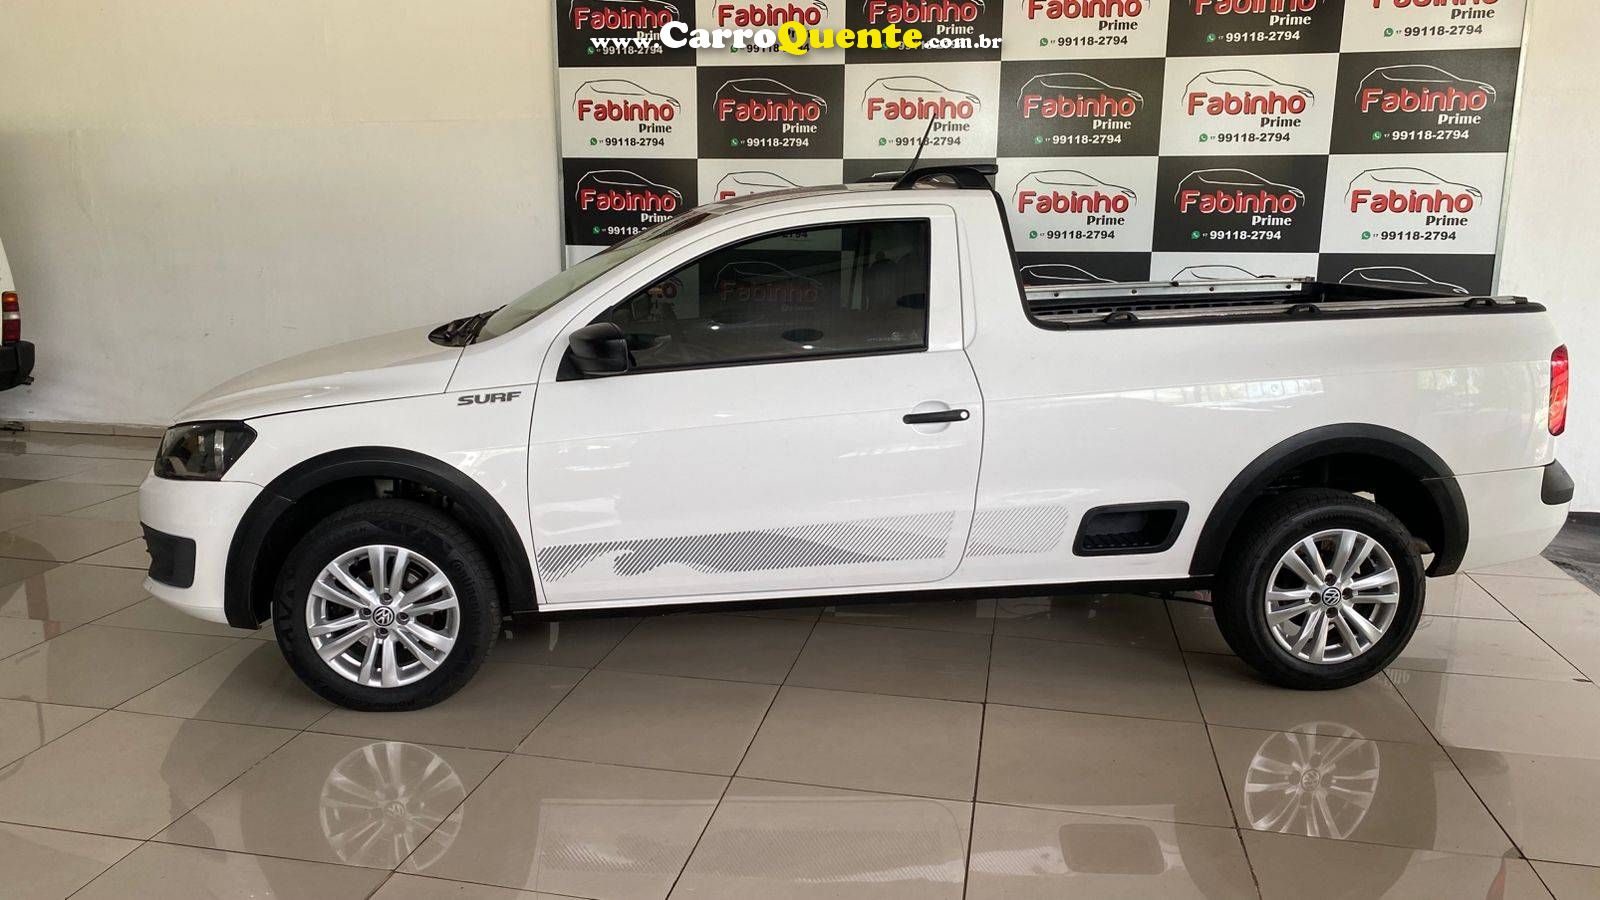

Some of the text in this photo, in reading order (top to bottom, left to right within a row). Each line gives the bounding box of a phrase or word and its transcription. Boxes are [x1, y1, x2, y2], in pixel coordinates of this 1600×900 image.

[718, 3, 821, 27] Fabinho
[868, 0, 978, 24] Fabinho
[1027, 0, 1143, 19] Fabinho
[1451, 8, 1495, 19] Prime
[574, 7, 673, 29] Fabinho
[1269, 14, 1312, 25] Prime
[936, 24, 974, 35] Prime
[1098, 20, 1138, 30] Prime
[1404, 25, 1482, 36] 99118-2794
[636, 30, 660, 40] Prim
[1226, 31, 1300, 42] 99118-2794
[1058, 36, 1128, 46] 99118-2794
[1023, 93, 1135, 118] Fabinho
[1188, 91, 1306, 115] Fabinho
[1361, 88, 1487, 112] Fabinho
[577, 99, 675, 121] Fabinho
[718, 98, 821, 121] Fabinho
[867, 97, 974, 120] Fabinho
[1093, 119, 1132, 129] Prime
[1260, 117, 1301, 127] Prime
[1438, 113, 1481, 124] Prime
[639, 123, 672, 133] Prime
[782, 123, 817, 133] Prime
[933, 121, 970, 132] Prime
[1052, 135, 1122, 144] 99118-2794
[1218, 132, 1290, 142] 99118-2794
[1392, 130, 1469, 140] 99118-2794
[605, 137, 665, 146] 99118-2794
[747, 138, 809, 147] 99118-2794
[896, 137, 961, 146] 99118-2794
[581, 189, 676, 212] Fabinho
[1018, 191, 1129, 213] Fabinho
[1180, 190, 1297, 213] Fabinho
[1350, 189, 1474, 213] Fabinho
[1087, 215, 1125, 225] Prime
[1252, 215, 1292, 226] Prime
[1425, 215, 1468, 226] Prime
[1047, 230, 1115, 239] 99118-2794
[1210, 231, 1281, 240] 99118-2794
[1381, 231, 1456, 240] 99118-2794
[457, 391, 521, 406] SURF
